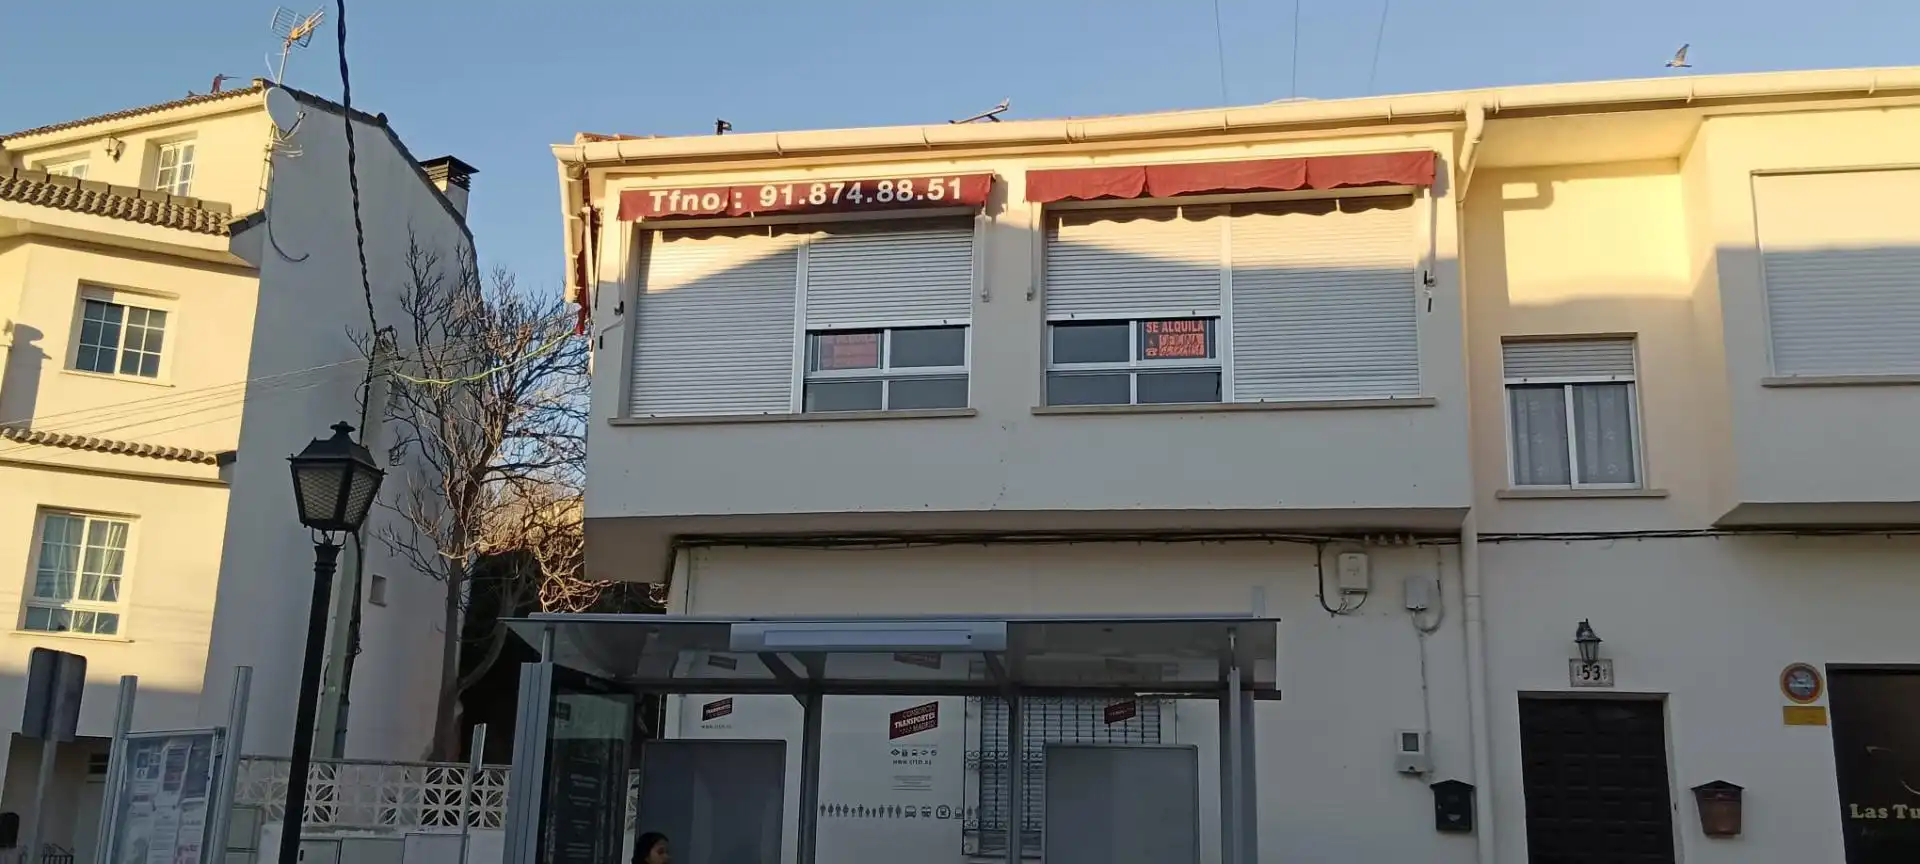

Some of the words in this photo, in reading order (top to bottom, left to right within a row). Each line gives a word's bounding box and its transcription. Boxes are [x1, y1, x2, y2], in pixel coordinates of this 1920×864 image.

[760, 177, 961, 207] 91.874.88.51
[1145, 321, 1159, 333] SE
[1161, 320, 1205, 333] ALQUILA
[1582, 663, 1601, 681] 53
[894, 711, 936, 729] TRANSPORTES
[1849, 803, 1889, 819] Las
